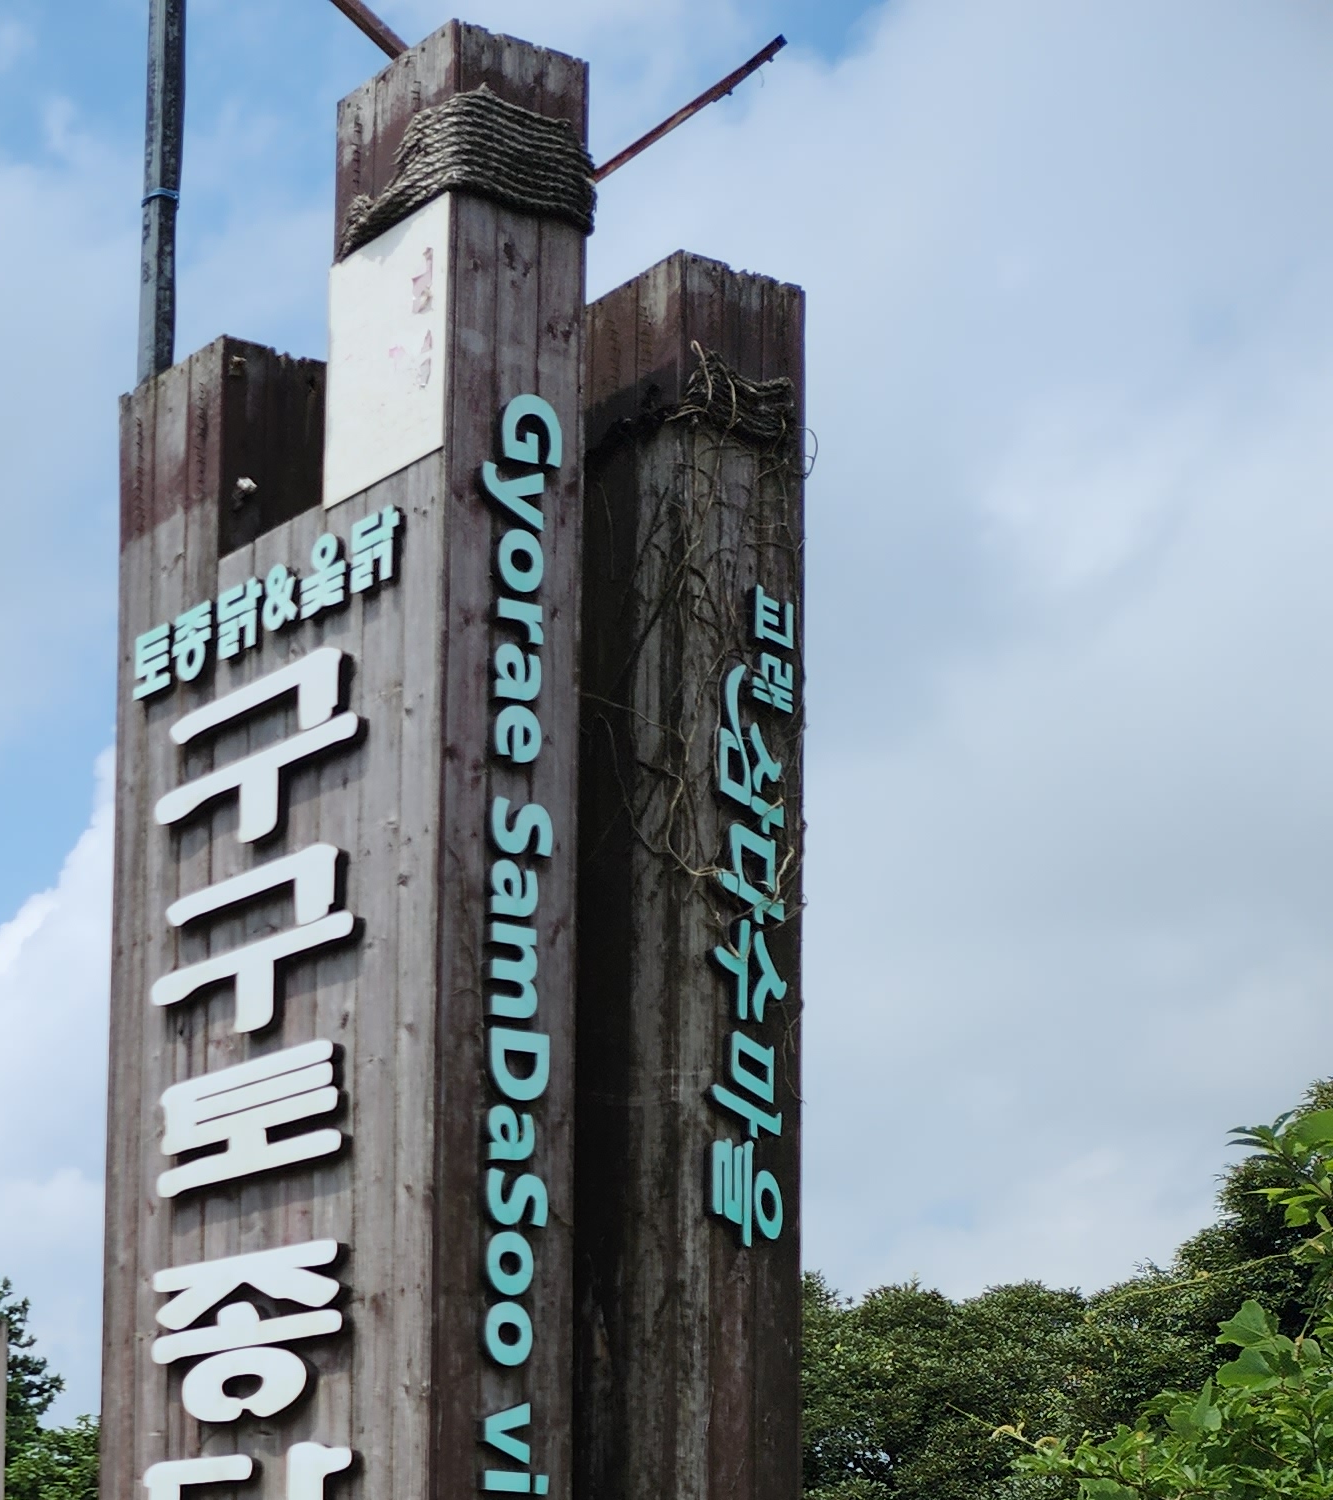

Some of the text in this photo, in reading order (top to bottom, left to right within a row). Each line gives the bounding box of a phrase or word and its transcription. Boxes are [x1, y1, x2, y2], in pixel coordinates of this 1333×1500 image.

[483, 393, 562, 764] Gyorae
[752, 583, 794, 715] 교래
[483, 796, 554, 1367] SamDaSoo
